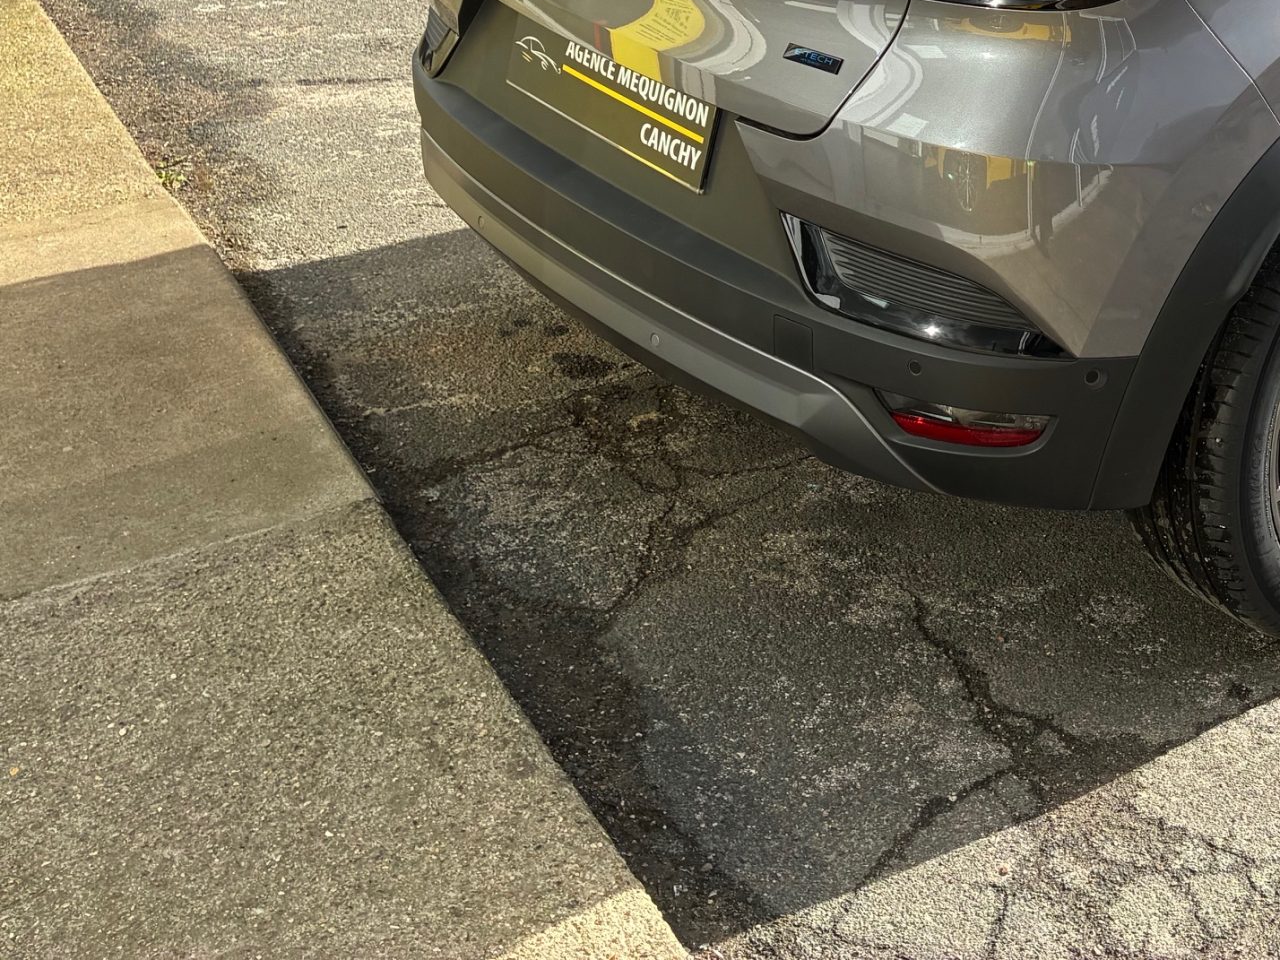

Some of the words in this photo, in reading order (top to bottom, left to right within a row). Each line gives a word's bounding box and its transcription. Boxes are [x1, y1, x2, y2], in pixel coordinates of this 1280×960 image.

[565, 40, 616, 80] AGENCE
[617, 65, 710, 128] MEQUIGNON
[640, 123, 702, 170] CANCHY
